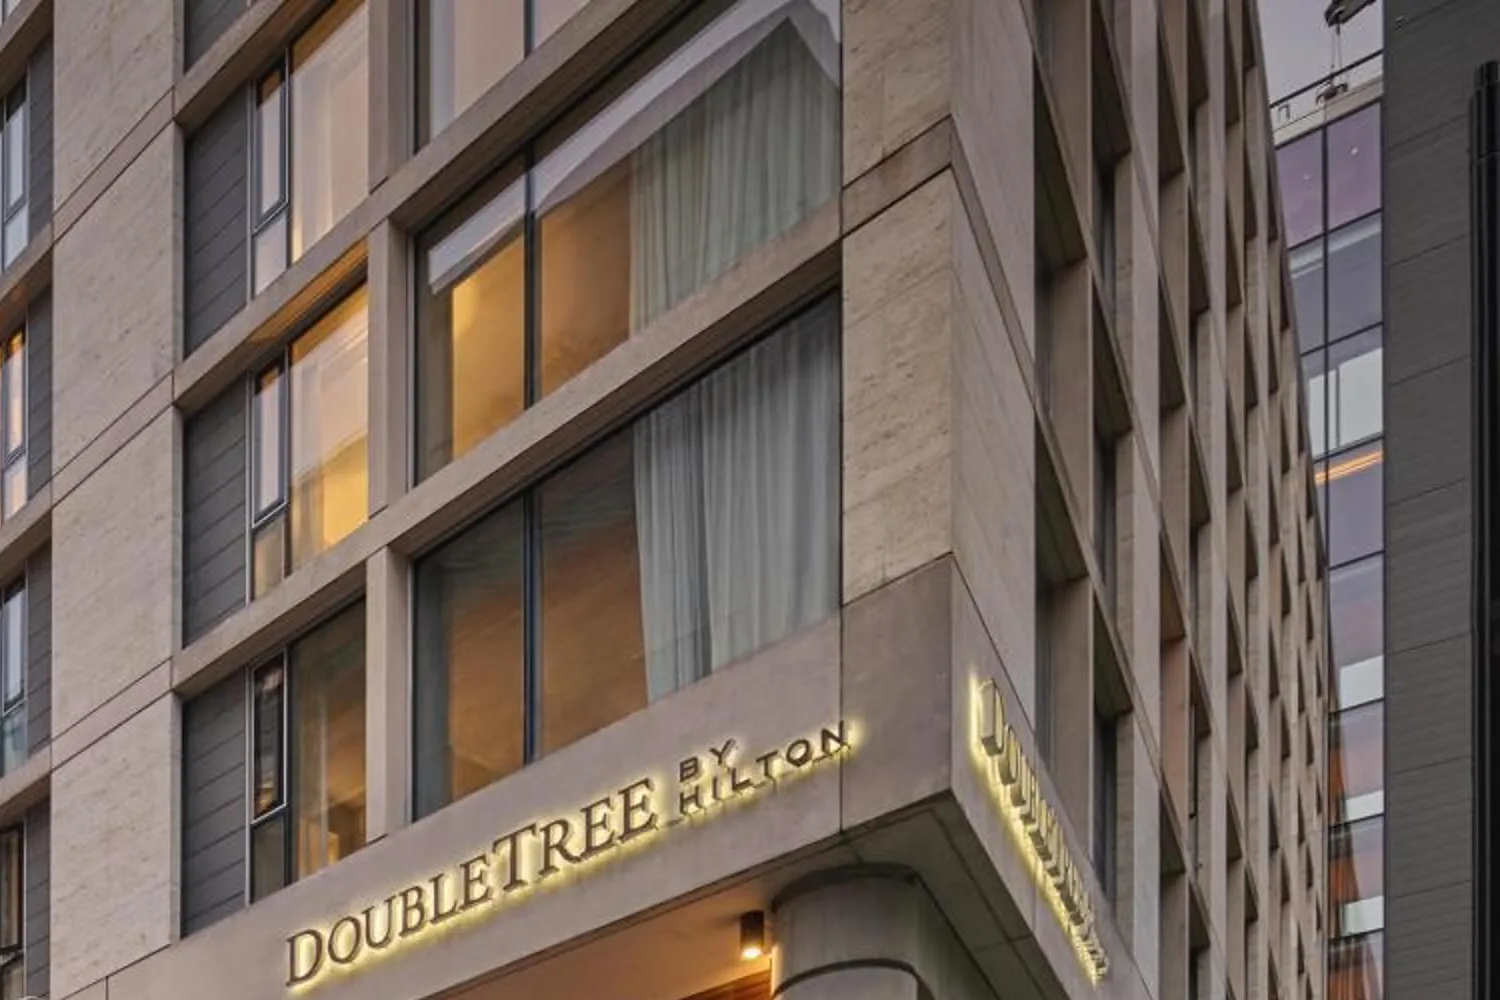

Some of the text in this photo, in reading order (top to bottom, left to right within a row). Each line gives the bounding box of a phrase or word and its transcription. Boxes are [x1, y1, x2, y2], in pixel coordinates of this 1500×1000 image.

[679, 737, 736, 783] BY
[679, 719, 846, 815] HILTON
[286, 777, 660, 988] DOUBLETREE
